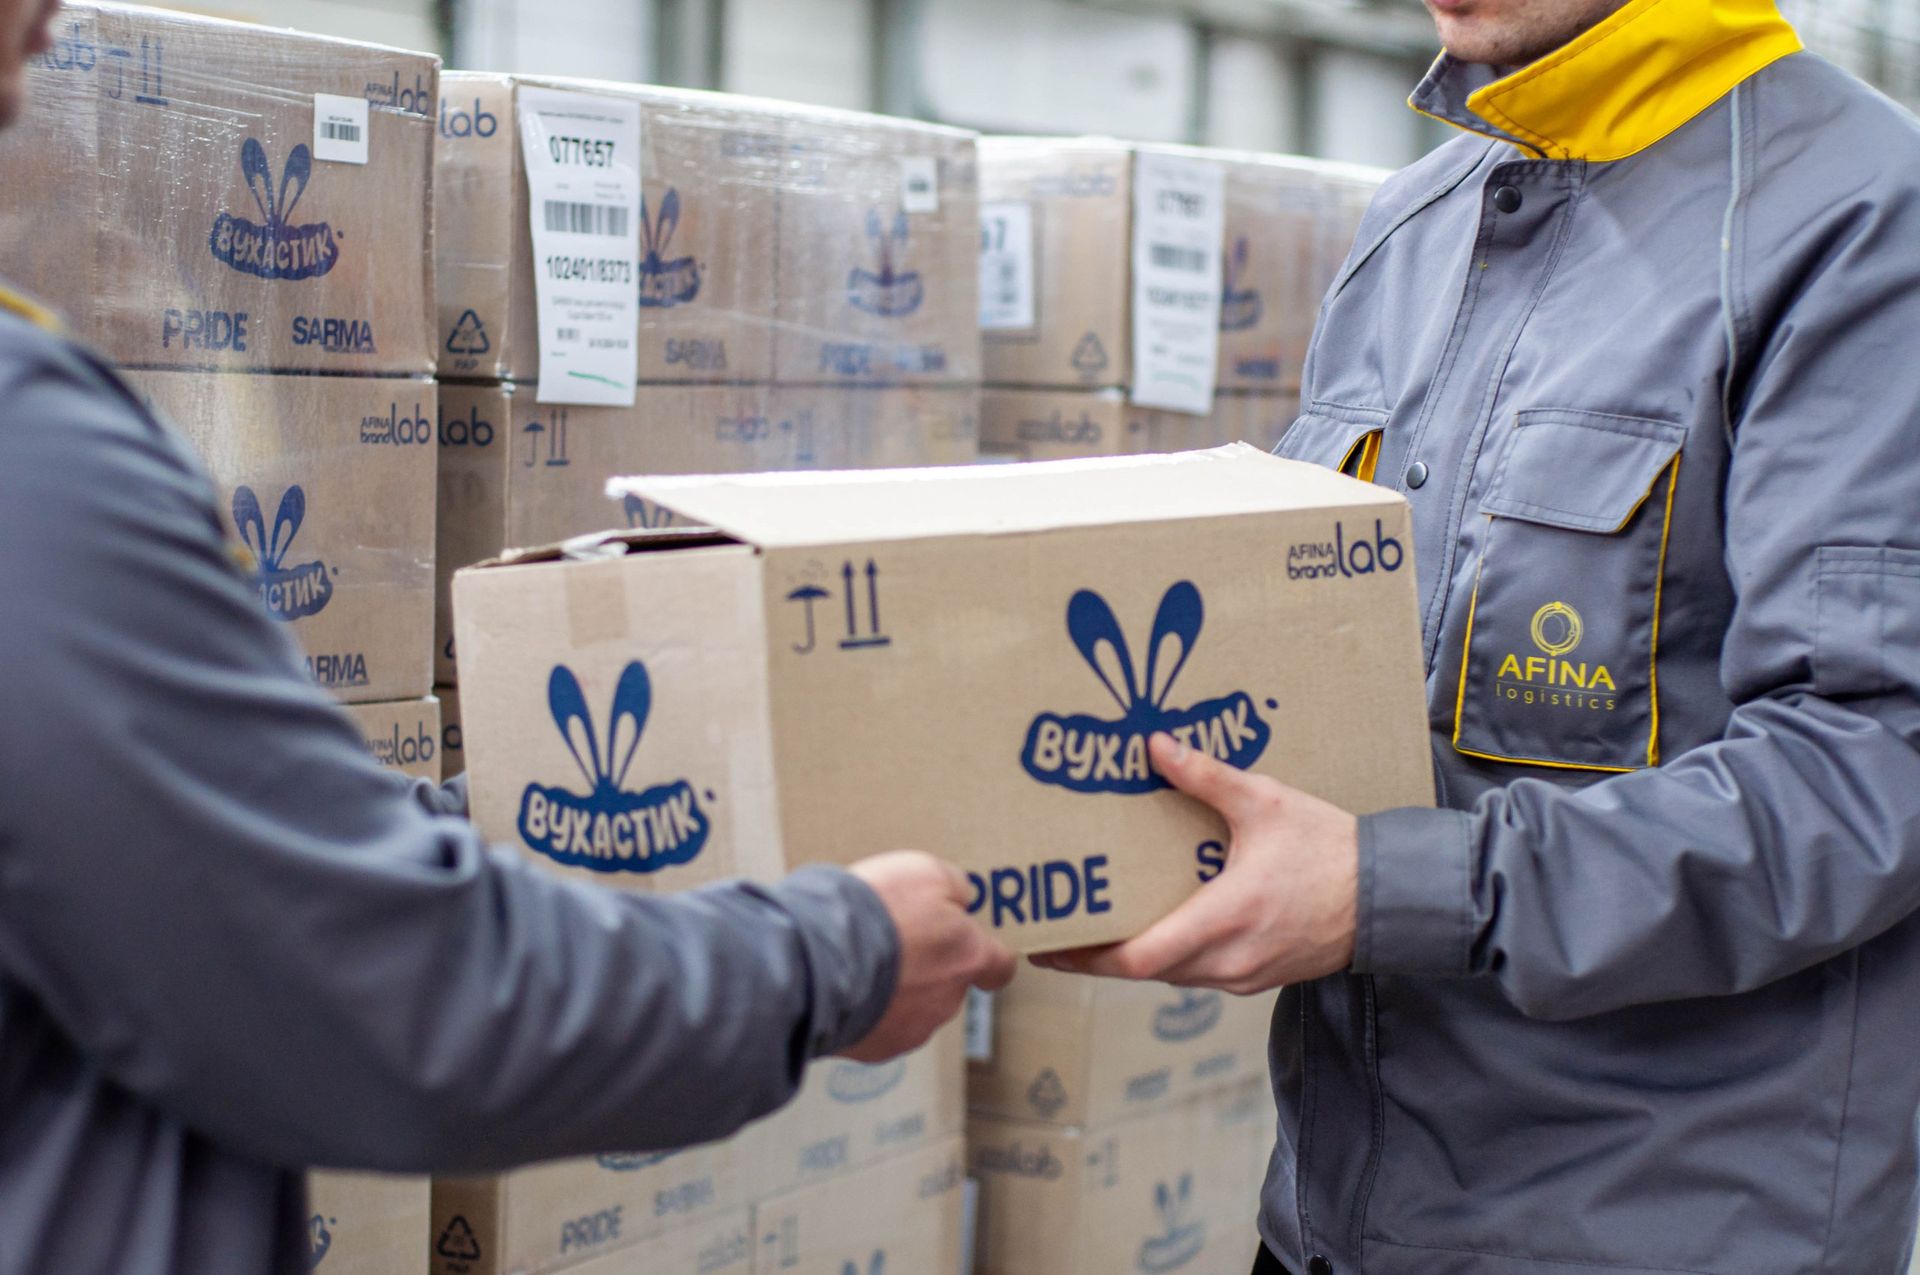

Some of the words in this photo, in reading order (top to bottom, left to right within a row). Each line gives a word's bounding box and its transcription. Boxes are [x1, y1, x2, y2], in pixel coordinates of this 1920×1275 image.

[440, 97, 497, 138] lab
[549, 135, 615, 167] 077657
[162, 308, 248, 352] PRIDE
[292, 315, 374, 348] SARMA
[390, 402, 431, 446] lab
[437, 404, 494, 447] lab
[1287, 556, 1338, 580] brand
[1335, 518, 1404, 578] lab
[1288, 542, 1336, 560] AFINA
[1497, 653, 1617, 691] AFINA
[1495, 682, 1616, 711] logistics
[393, 720, 435, 766] lab
[1033, 699, 1258, 782] ВУХАТИК
[526, 788, 700, 860] ВУХАСТИК
